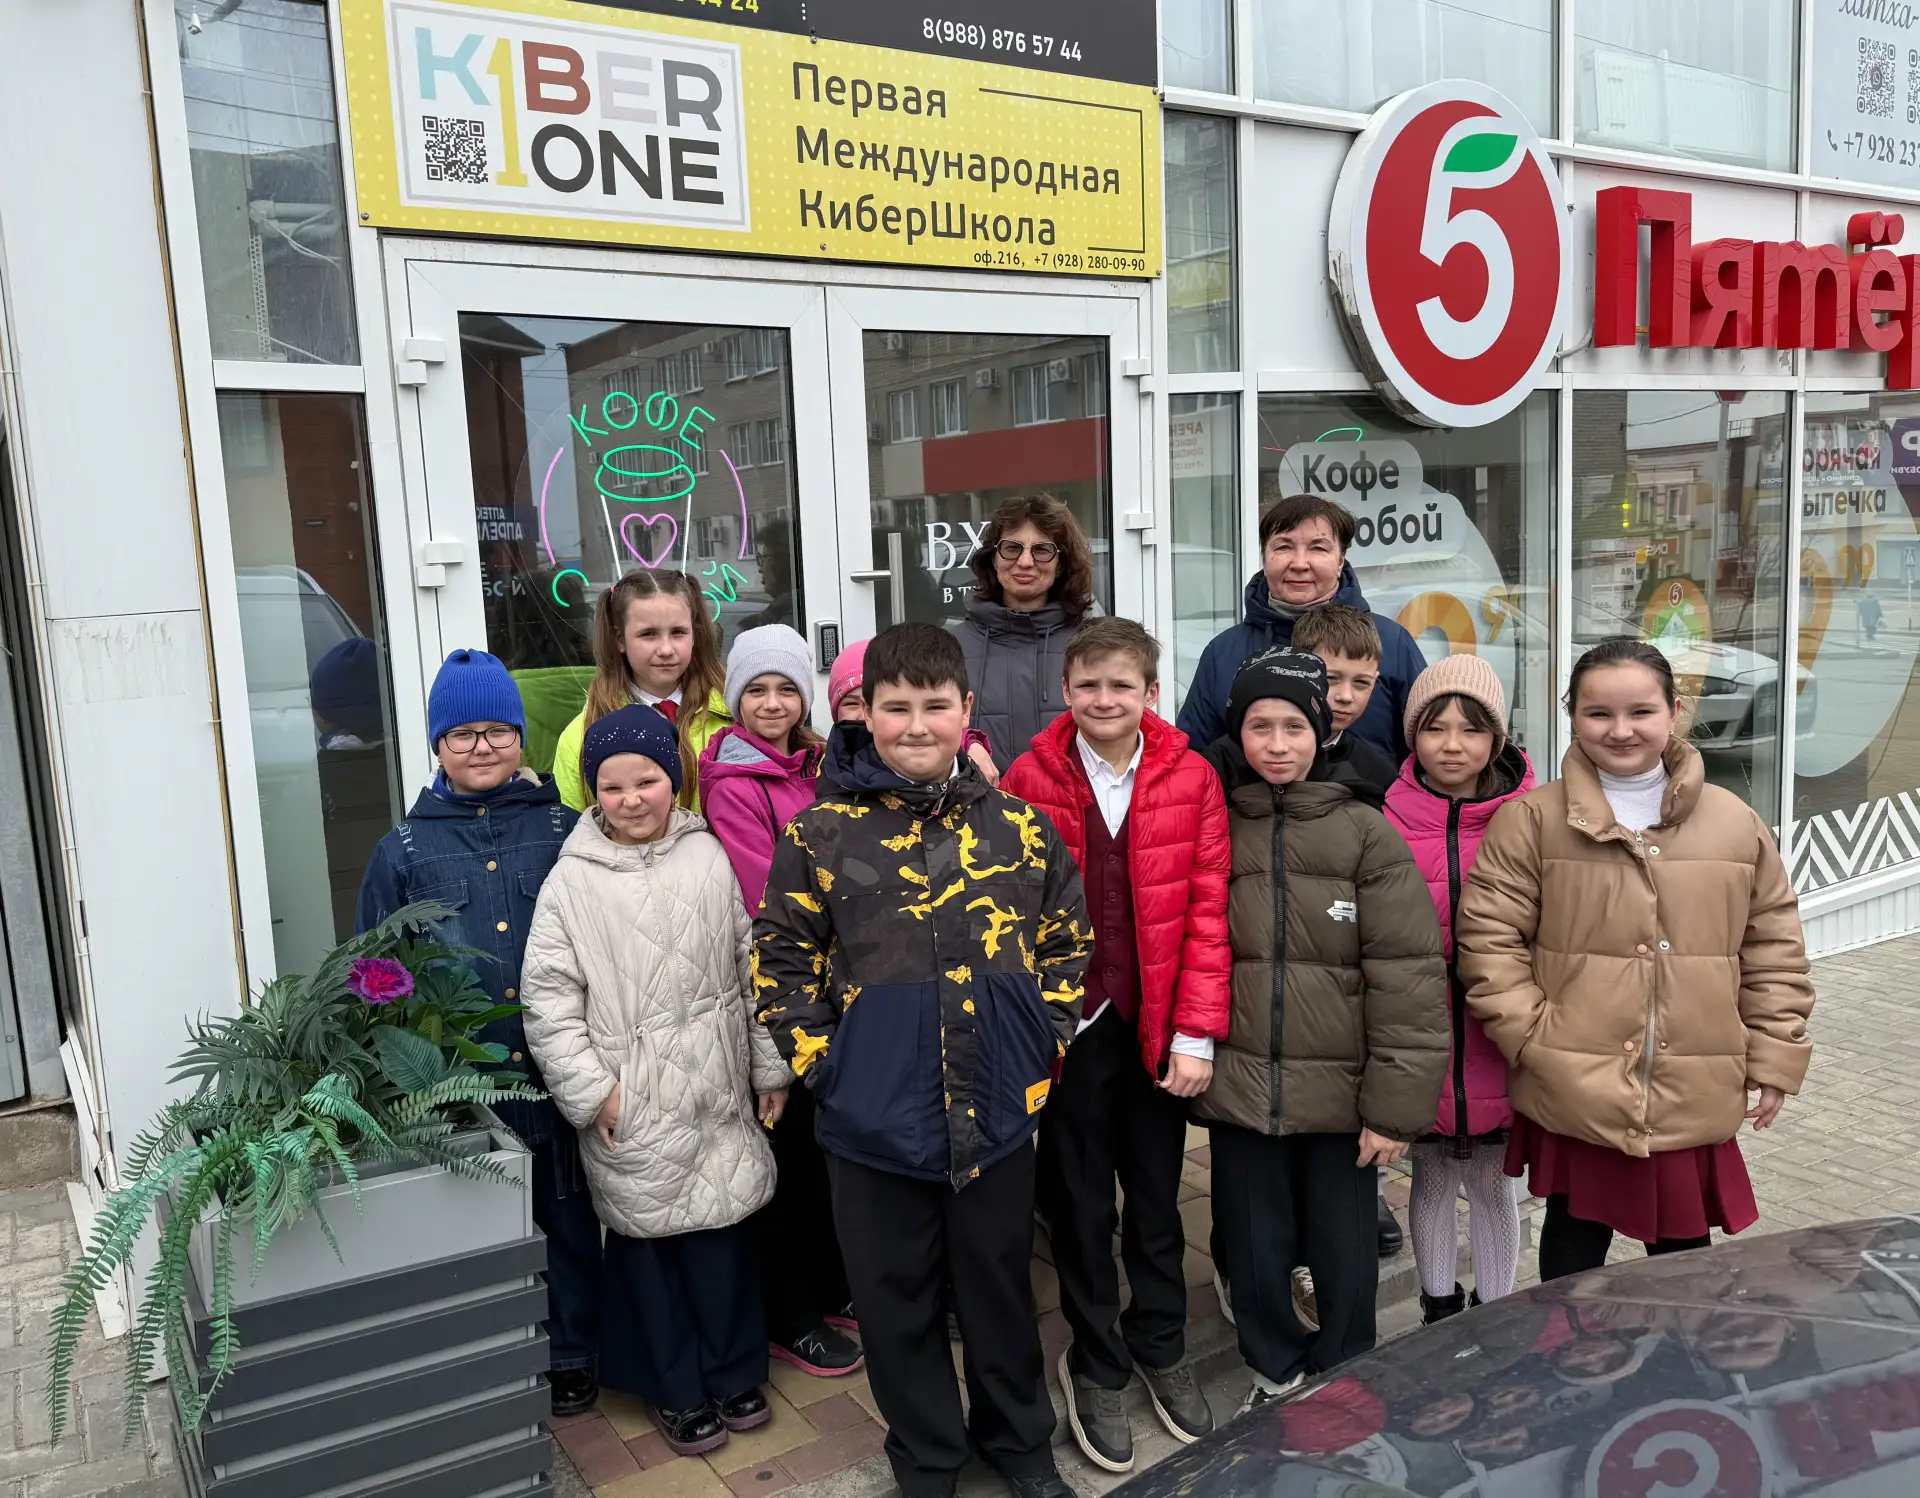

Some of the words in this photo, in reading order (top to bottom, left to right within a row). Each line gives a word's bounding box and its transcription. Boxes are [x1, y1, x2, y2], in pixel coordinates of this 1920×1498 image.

[923, 17, 986, 50] 8(988)
[992, 29, 1026, 52] 876
[1032, 34, 1054, 57] 57
[1060, 39, 1082, 61] 44
[793, 61, 947, 118] Первая
[531, 123, 725, 206] ONE
[796, 125, 1120, 196] Международная
[1843, 131, 1863, 158] +7
[1868, 134, 1894, 163] 928
[1899, 139, 1920, 168] 23
[799, 188, 1056, 246] КиберШкола
[974, 250, 1025, 267] оф.216,
[1034, 253, 1049, 266] +7
[1053, 252, 1084, 270] (928)
[1088, 256, 1146, 271] 280-09-90
[1301, 450, 1400, 501] Кофе
[1803, 446, 1881, 472] орячая
[1803, 489, 1886, 516] ыпечка
[1354, 503, 1443, 547] обой
